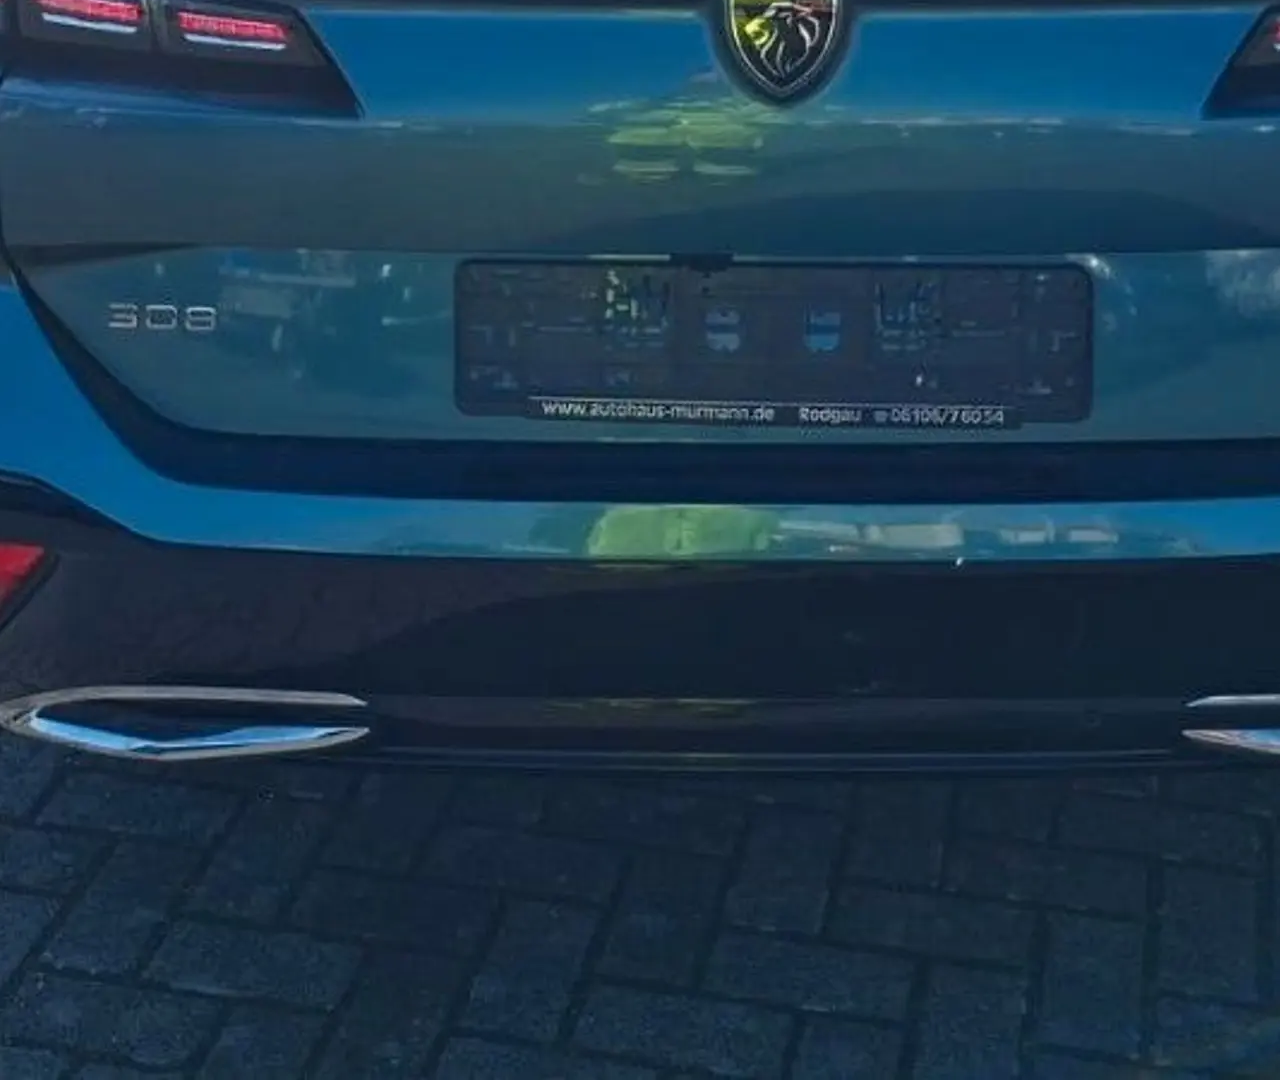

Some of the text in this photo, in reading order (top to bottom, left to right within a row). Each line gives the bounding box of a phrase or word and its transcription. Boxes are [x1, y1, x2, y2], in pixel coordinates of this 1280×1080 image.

[107, 303, 217, 331] 308
[541, 400, 775, 423] www.autohaus-murmann.de
[798, 406, 862, 424] Rodgau
